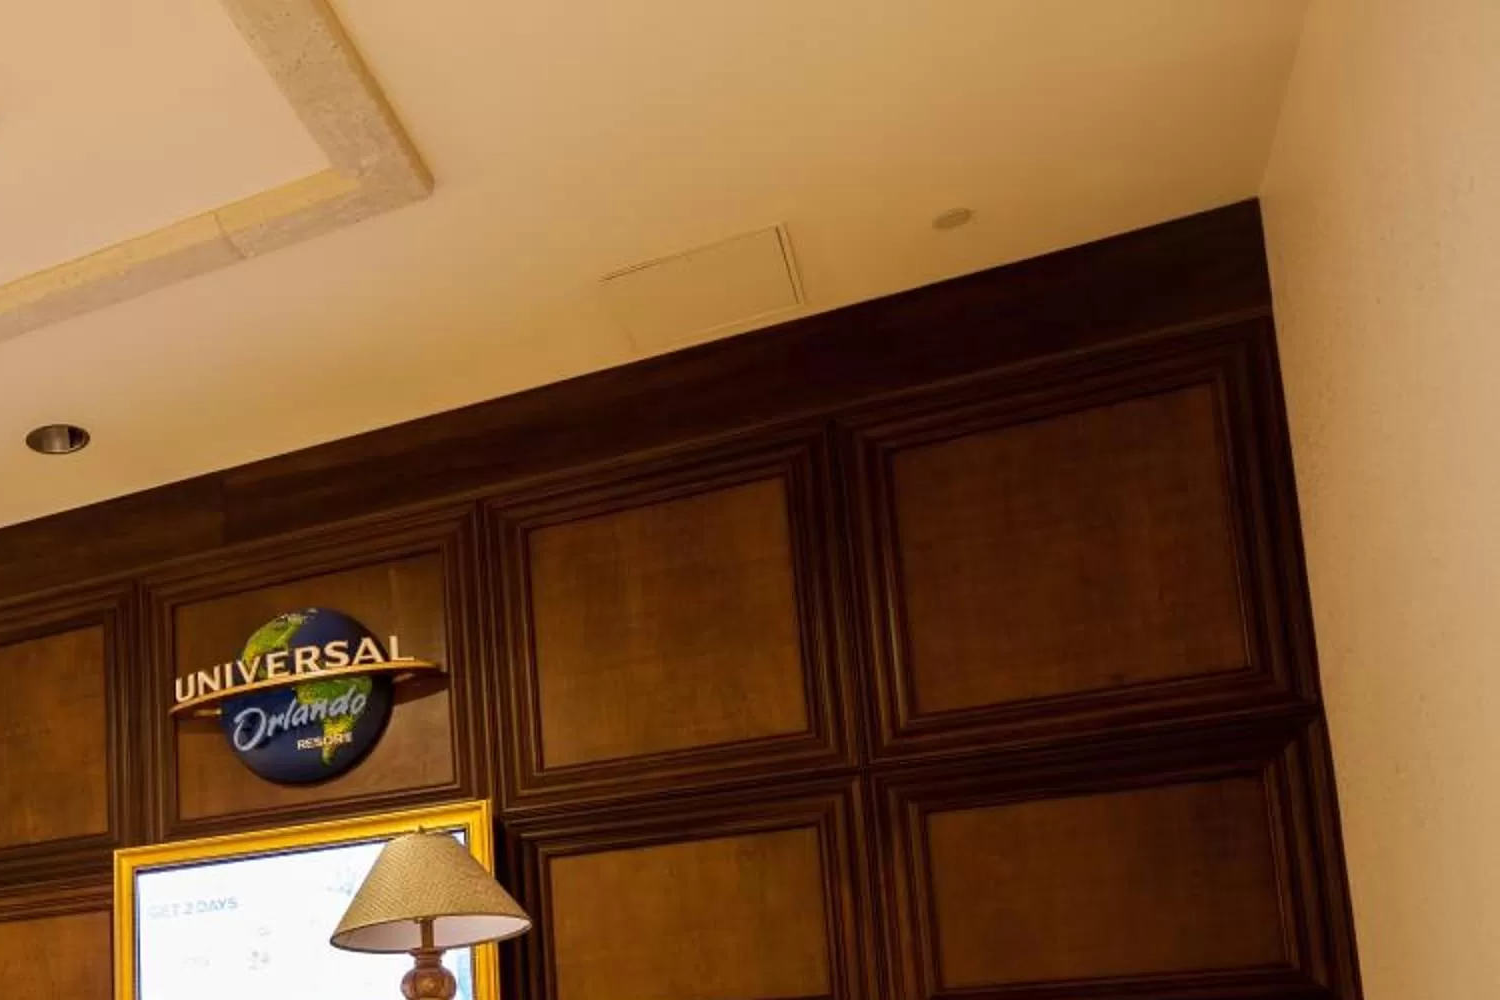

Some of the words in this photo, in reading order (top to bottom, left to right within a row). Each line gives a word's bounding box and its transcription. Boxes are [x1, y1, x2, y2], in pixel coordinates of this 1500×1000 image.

[174, 635, 415, 703] UNIVERSAL
[233, 684, 368, 751] Orlando
[297, 731, 353, 750] RESORT
[196, 896, 238, 914] DAYS
